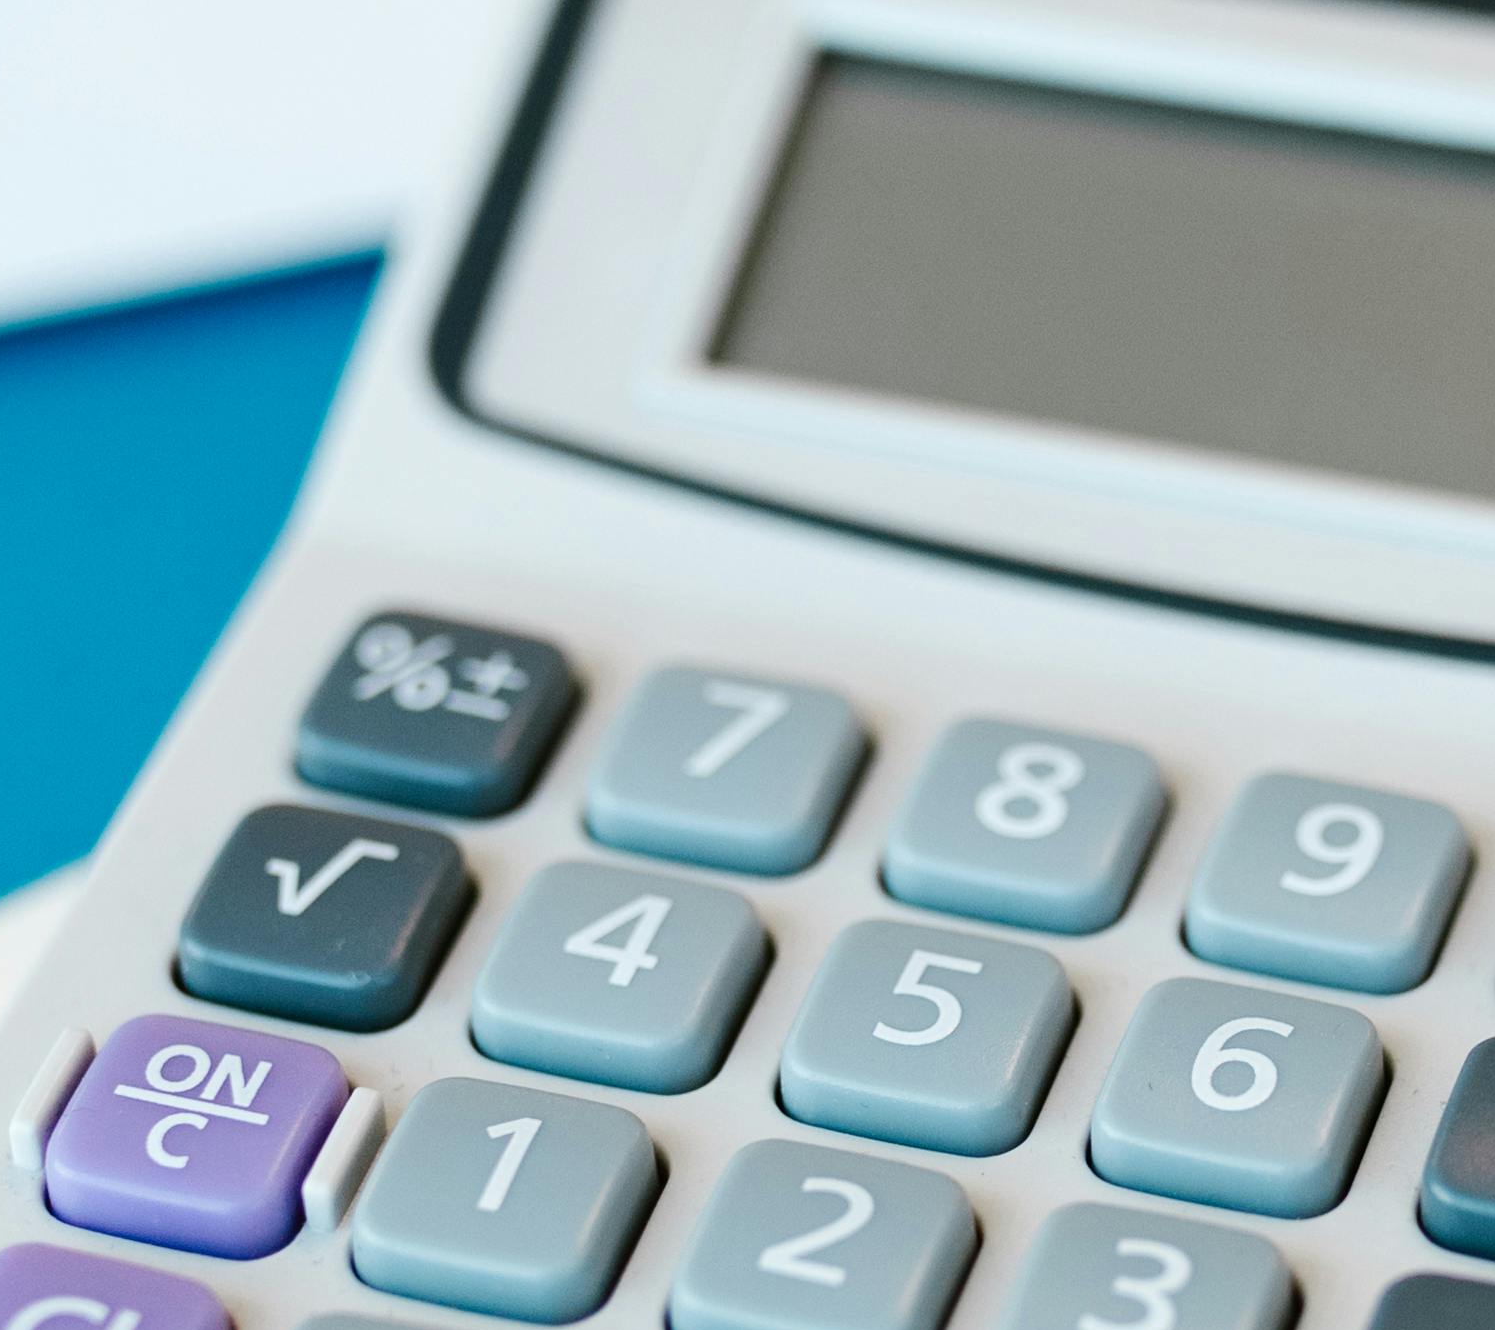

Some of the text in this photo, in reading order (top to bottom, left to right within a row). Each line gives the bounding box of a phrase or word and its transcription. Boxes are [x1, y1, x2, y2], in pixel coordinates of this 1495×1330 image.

[684, 680, 787, 778] 7
[974, 743, 1085, 840] 8
[1280, 803, 1384, 897] 9
[563, 894, 673, 987] 4
[872, 950, 984, 1047] 5
[145, 1043, 273, 1108] ON
[1190, 1017, 1294, 1112] 6
[145, 1111, 209, 1169] C
[477, 1116, 543, 1212] 1
[757, 1177, 876, 1288] 2
